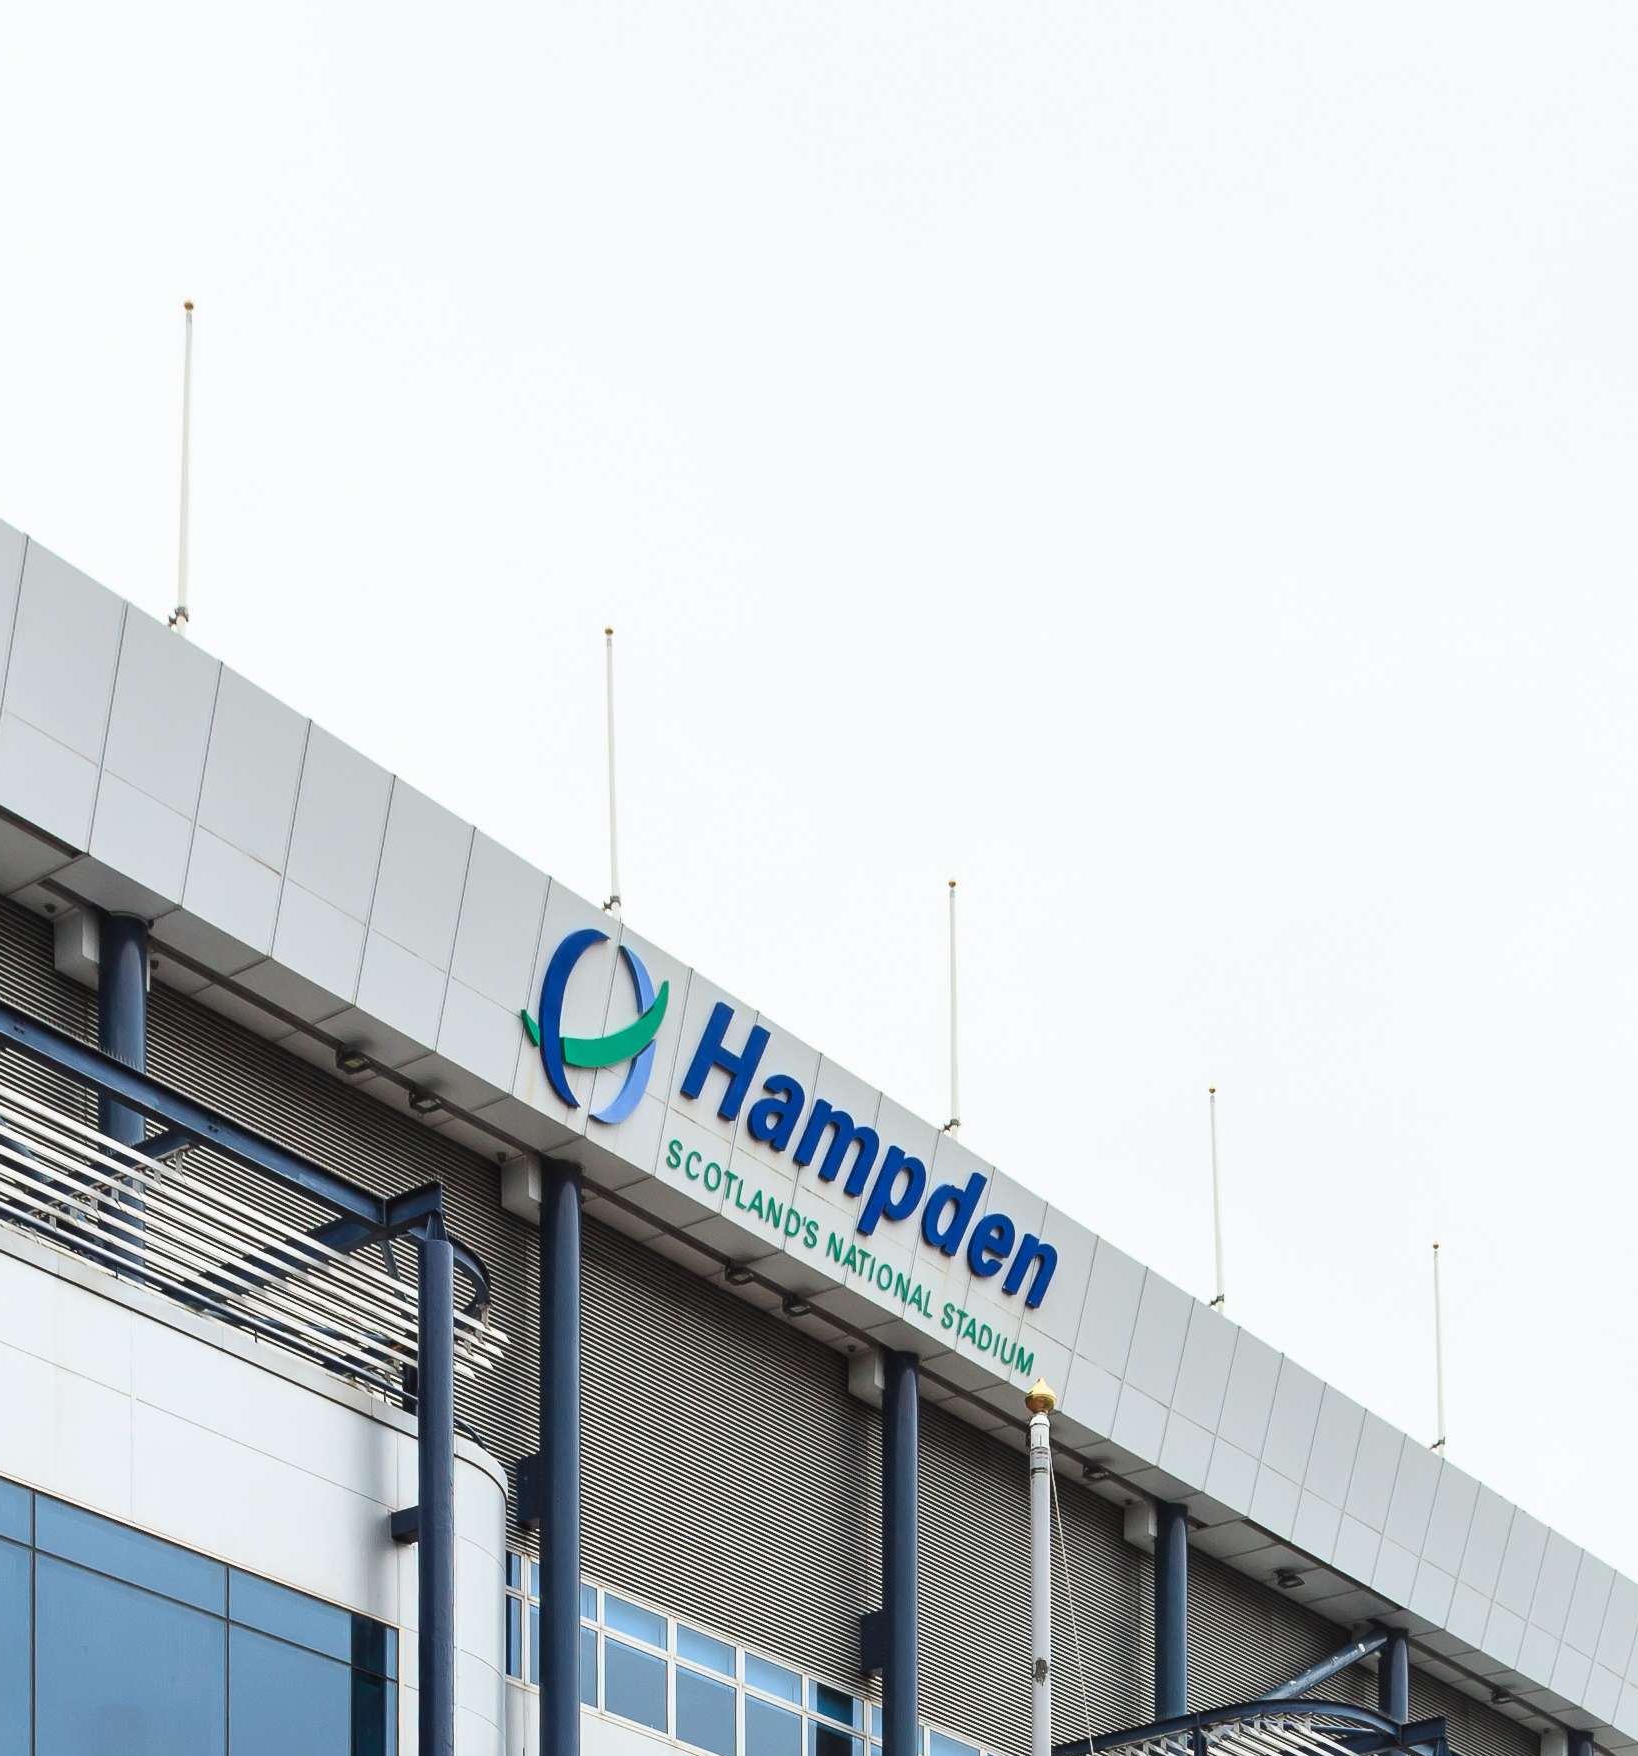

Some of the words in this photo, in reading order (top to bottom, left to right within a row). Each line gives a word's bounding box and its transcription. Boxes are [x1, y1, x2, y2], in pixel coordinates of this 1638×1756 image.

[666, 1139, 820, 1249] SCOTLAND'S
[826, 1233, 934, 1320] NATIONAL
[941, 1306, 1035, 1378] STADIUM
[680, 1002, 1058, 1310] Hampden
